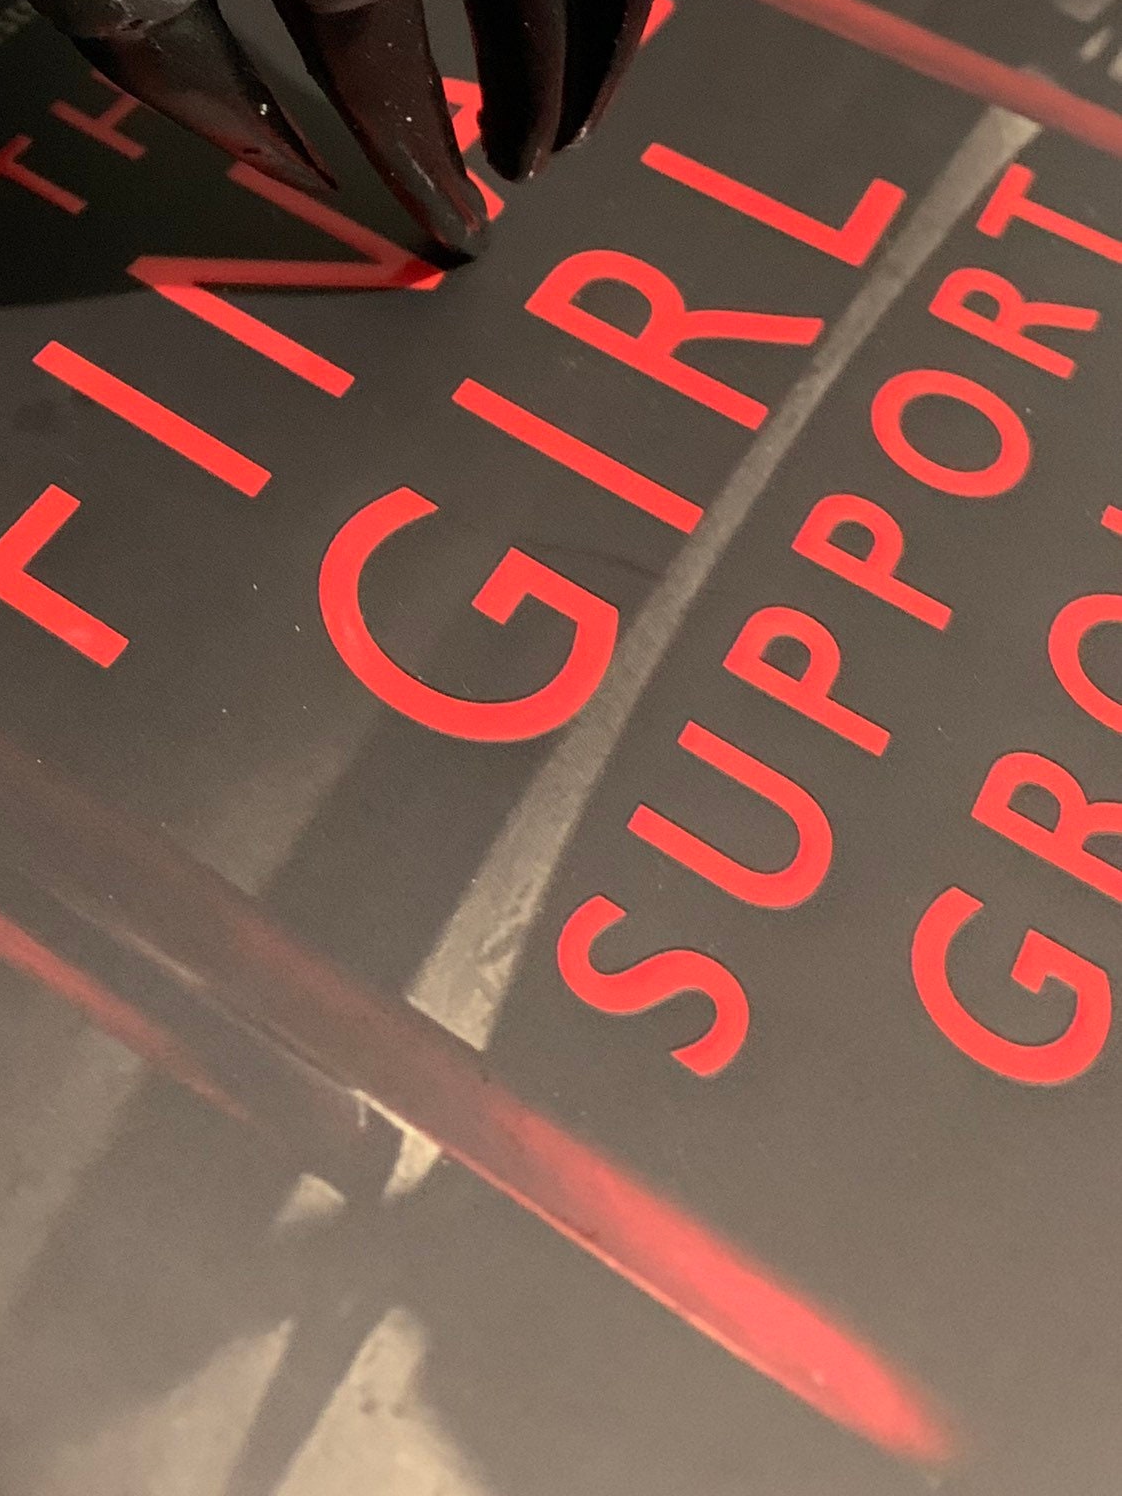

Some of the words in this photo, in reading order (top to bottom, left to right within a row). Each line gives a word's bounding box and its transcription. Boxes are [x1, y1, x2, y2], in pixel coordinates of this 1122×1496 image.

[318, 143, 907, 744] GIRL
[557, 163, 1122, 1079] SUPPORT
[910, 504, 1122, 1086] GR
